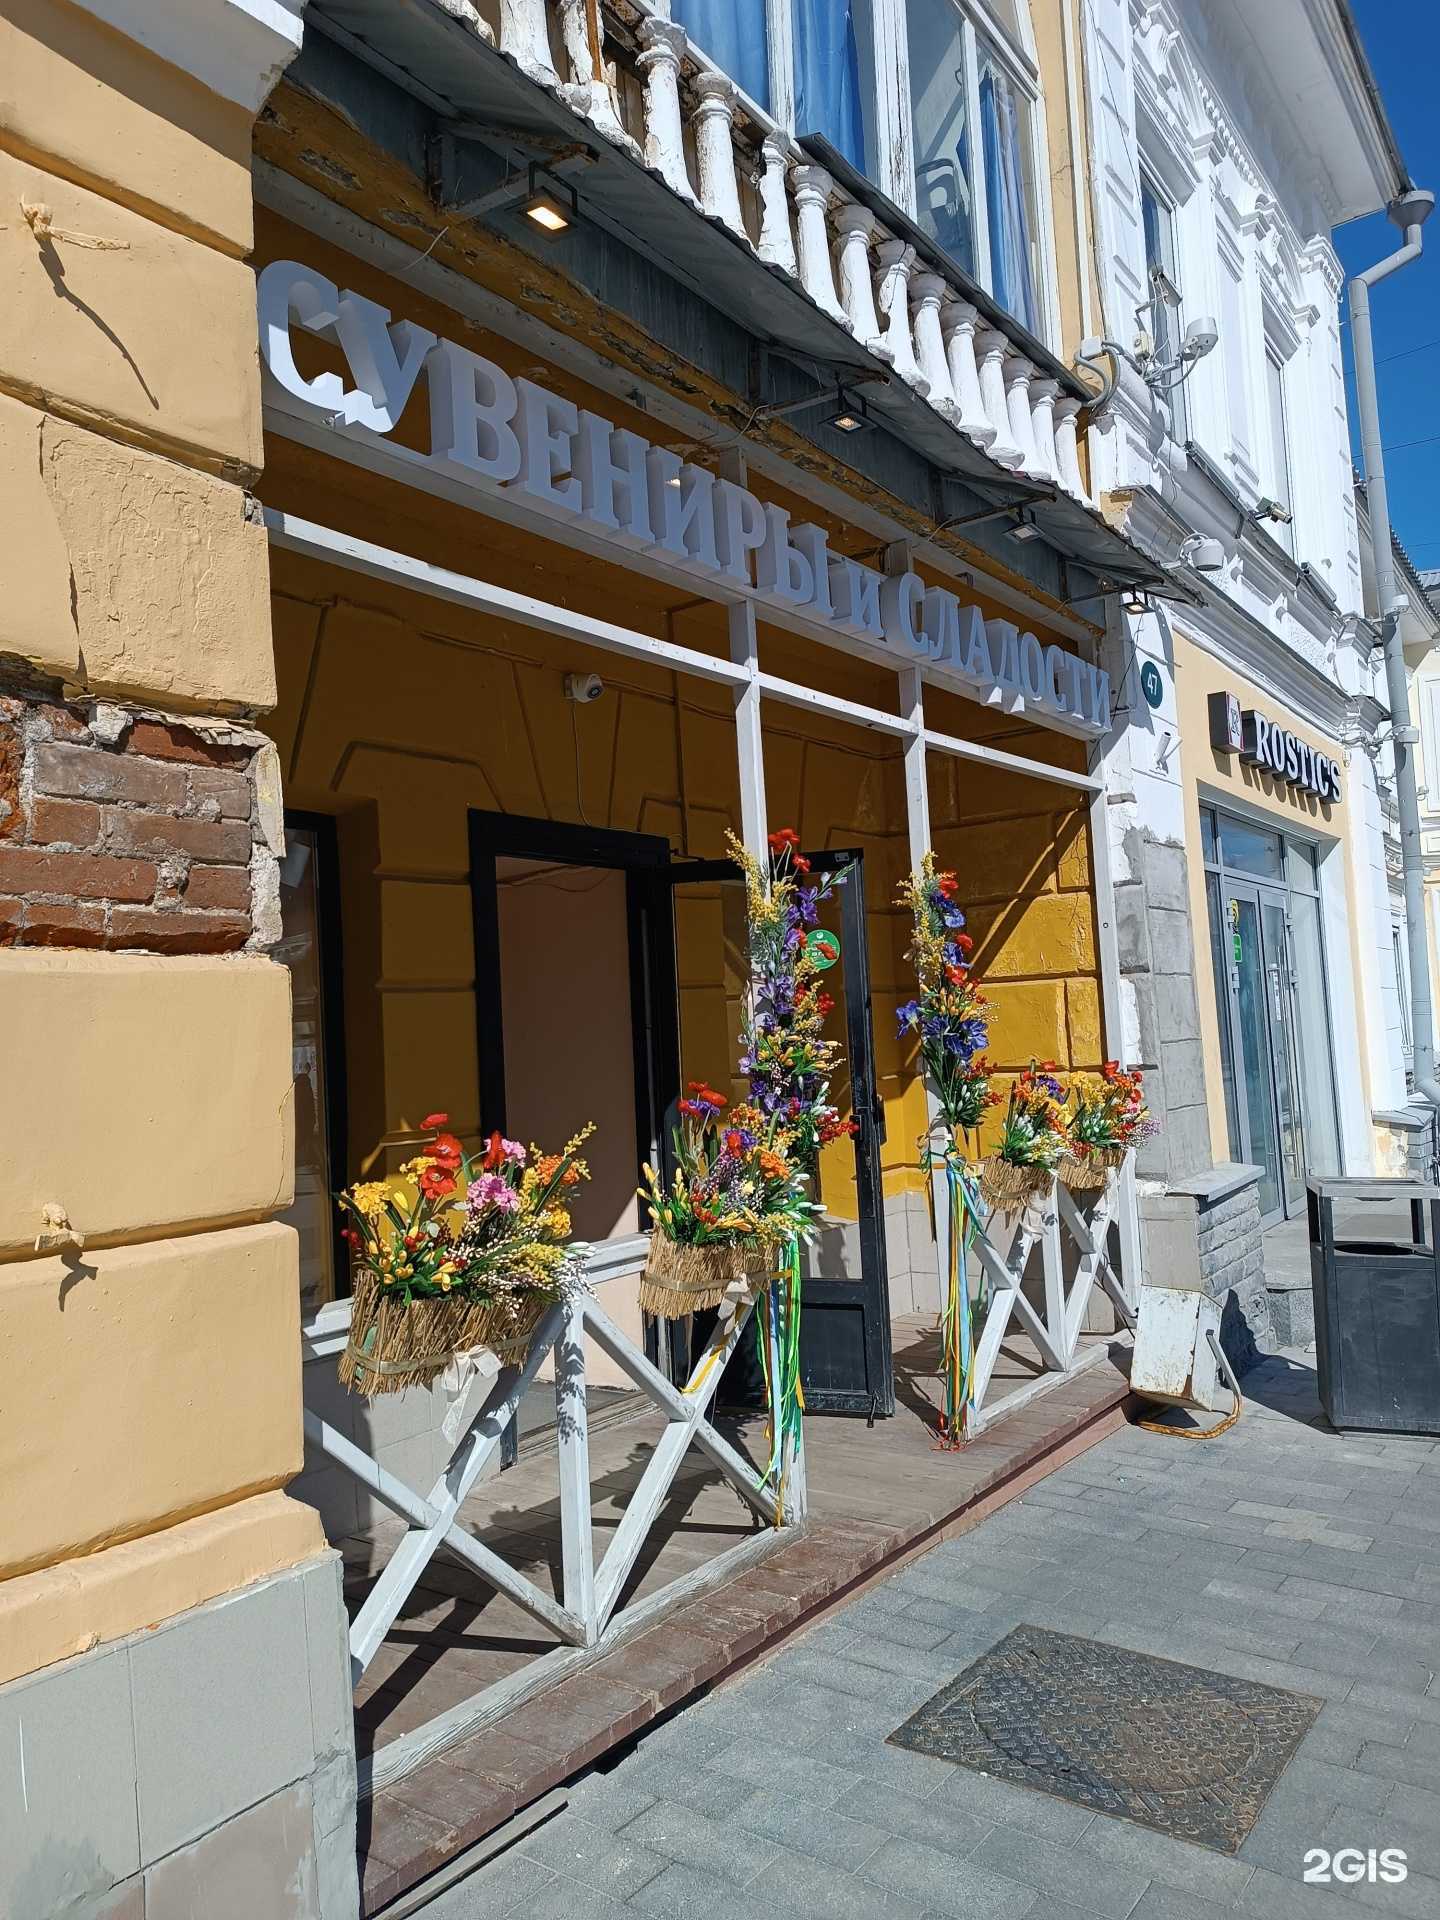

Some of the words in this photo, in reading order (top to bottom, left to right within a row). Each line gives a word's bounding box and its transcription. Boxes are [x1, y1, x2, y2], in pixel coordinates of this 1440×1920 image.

[257, 259, 834, 617] СУВЕНИРЫ
[844, 562, 886, 637] И
[898, 571, 1113, 732] СЛАДОСТИ
[1147, 671, 1158, 696] 47
[1254, 709, 1342, 803] ROSTIC'S
